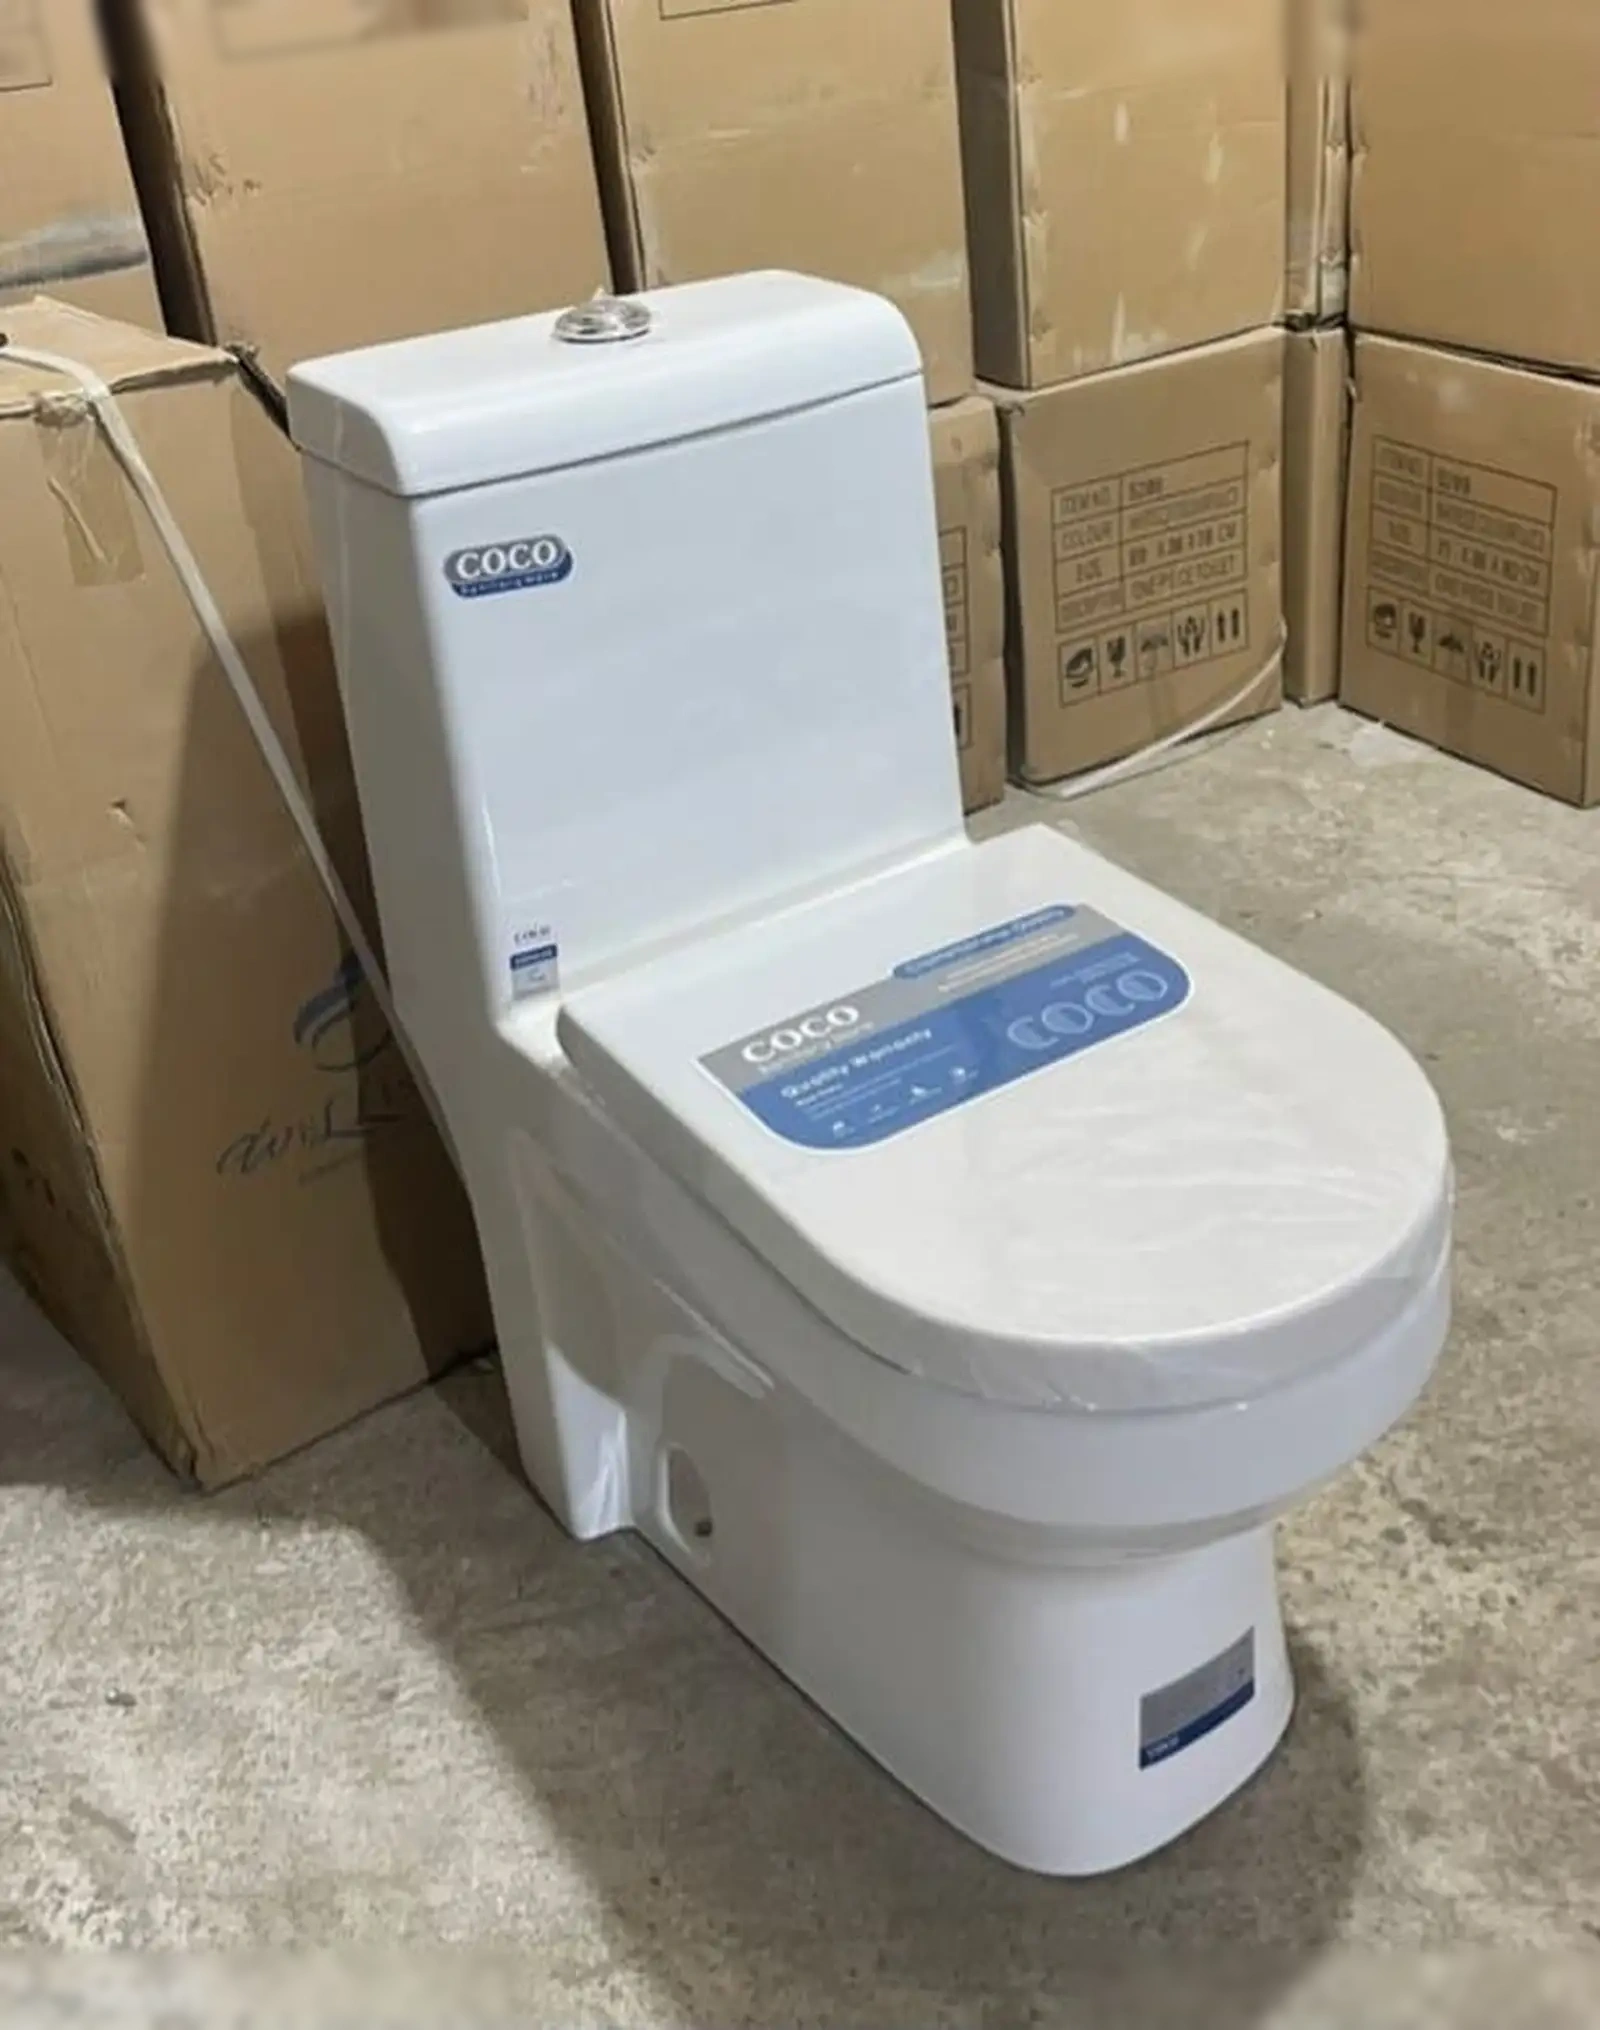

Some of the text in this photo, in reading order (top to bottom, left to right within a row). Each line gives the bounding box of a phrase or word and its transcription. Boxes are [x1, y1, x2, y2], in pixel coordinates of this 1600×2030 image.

[456, 540, 557, 579] COCO
[1007, 969, 1168, 1049] COCO
[741, 1005, 859, 1062] COCO
[781, 1065, 849, 1098] Quality
